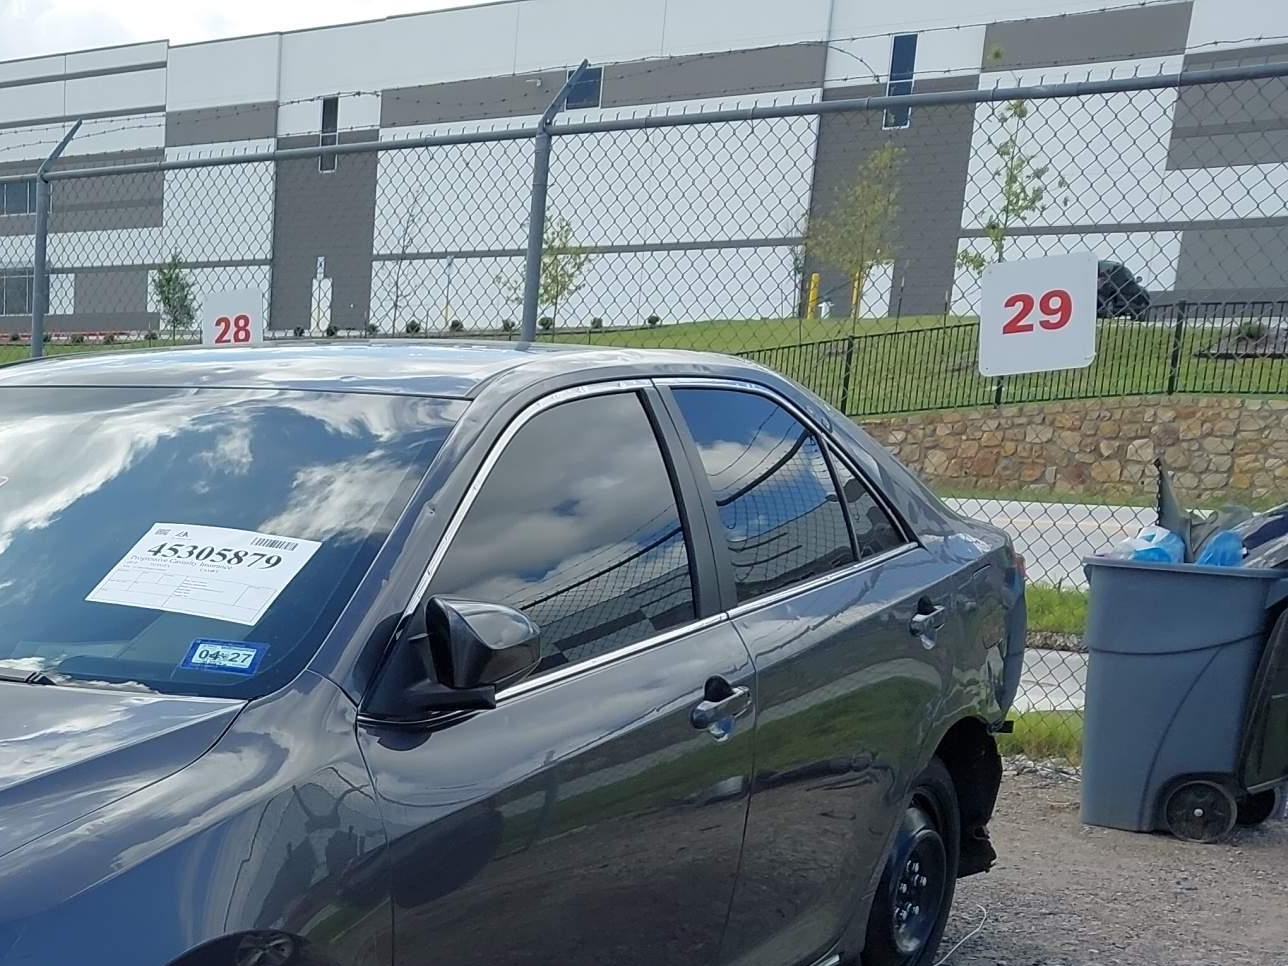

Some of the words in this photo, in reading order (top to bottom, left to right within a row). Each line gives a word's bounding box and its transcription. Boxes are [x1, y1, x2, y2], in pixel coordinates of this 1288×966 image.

[1002, 288, 1073, 335] 29
[215, 314, 252, 344] 28
[148, 542, 282, 570] 45305879
